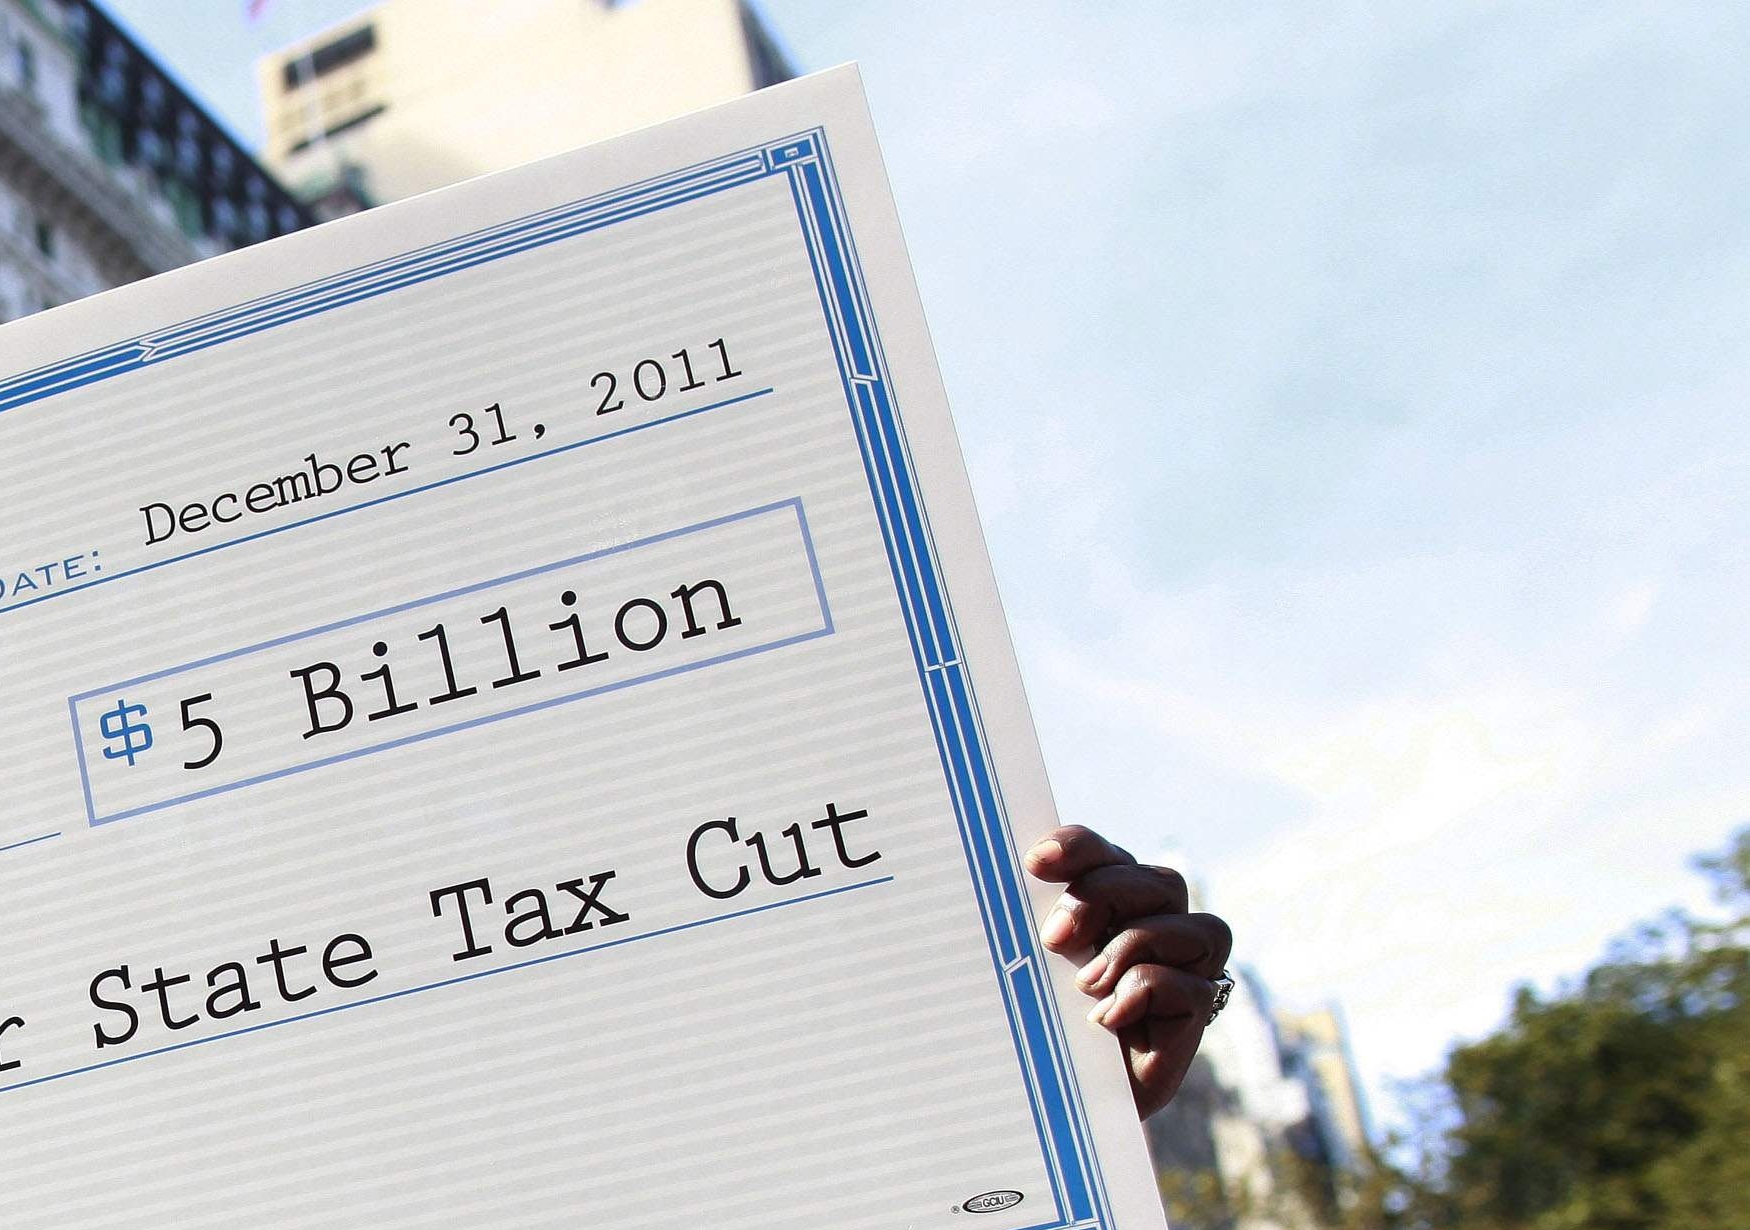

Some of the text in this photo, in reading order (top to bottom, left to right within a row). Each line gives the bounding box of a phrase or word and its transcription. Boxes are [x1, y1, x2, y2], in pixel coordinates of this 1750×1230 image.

[138, 442, 412, 547] December
[447, 402, 547, 457] 31,
[589, 337, 743, 417] 2011
[288, 579, 744, 741] Billion
[88, 927, 380, 1050] State
[428, 869, 631, 963] Tax
[685, 802, 883, 901] Cut
